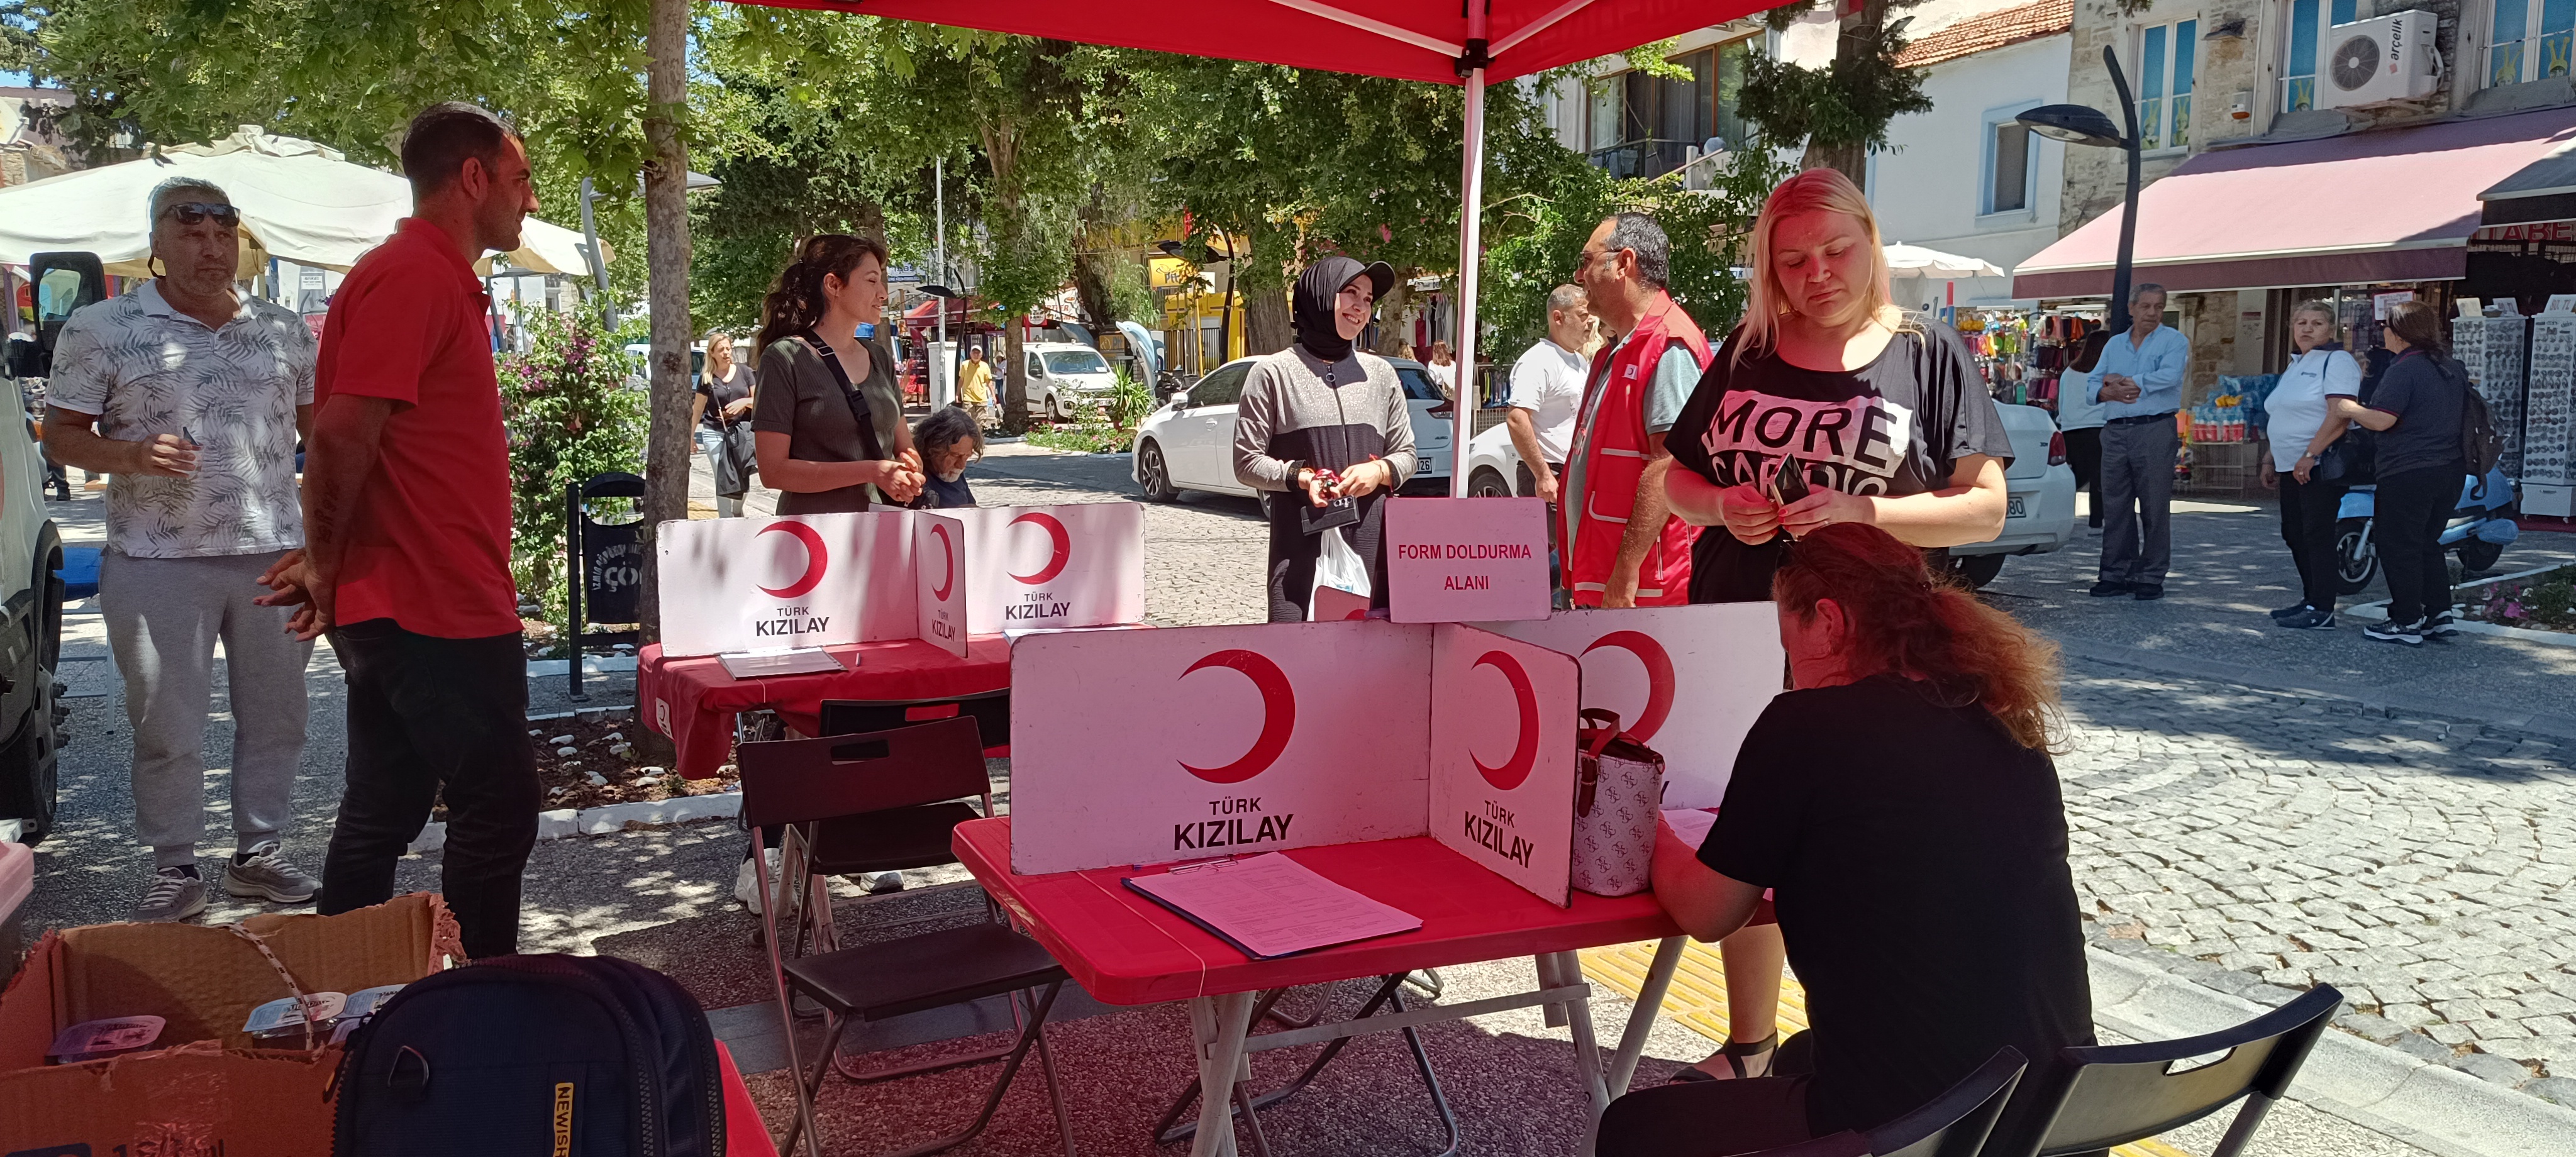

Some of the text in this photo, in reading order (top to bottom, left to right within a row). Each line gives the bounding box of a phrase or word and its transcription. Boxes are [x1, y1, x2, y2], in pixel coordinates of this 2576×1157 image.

[1706, 399, 1897, 470] MORE
[2006, 500, 2024, 515] 80
[1399, 544, 1532, 559] FORM DOLDURMA
[1444, 575, 1489, 590] ALANI
[1024, 591, 1053, 602] TÜRK
[777, 605, 809, 617] TÜRK
[938, 609, 949, 621] TÜRK
[1006, 602, 1071, 620] KIZILAY
[756, 617, 830, 636] KIZILAY
[931, 619, 956, 642] KIZILAY
[1209, 795, 1262, 816] TÜRK
[1484, 800, 1515, 829] TÜRK
[1174, 814, 1294, 851] KIZILAY
[1464, 811, 1534, 869] KIZILAY
[556, 1087, 571, 1157] NEWISH
